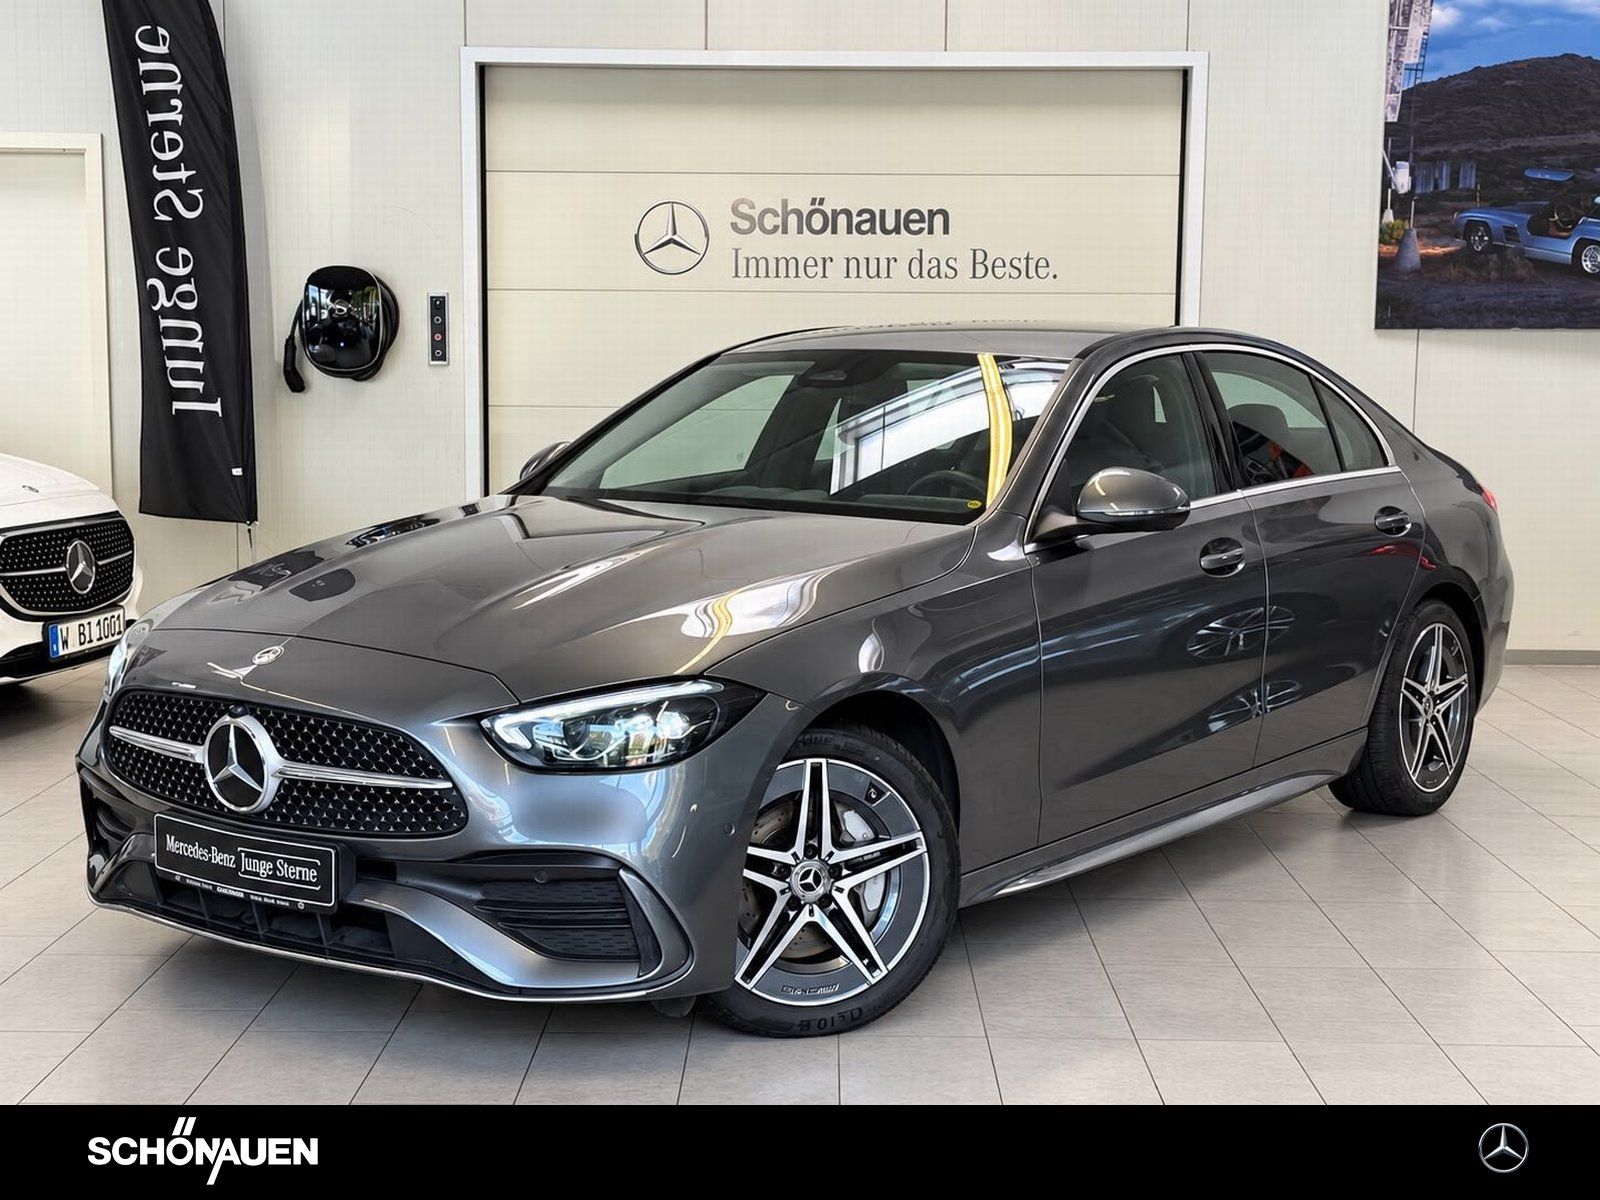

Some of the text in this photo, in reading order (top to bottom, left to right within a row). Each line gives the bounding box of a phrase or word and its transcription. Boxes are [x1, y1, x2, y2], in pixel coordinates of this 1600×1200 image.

[730, 197, 950, 236] Schönauen
[732, 247, 1058, 280] Immer nur das Beste.
[60, 627, 69, 650] W
[166, 834, 318, 882] Mercedes-Benz Junge Sterne
